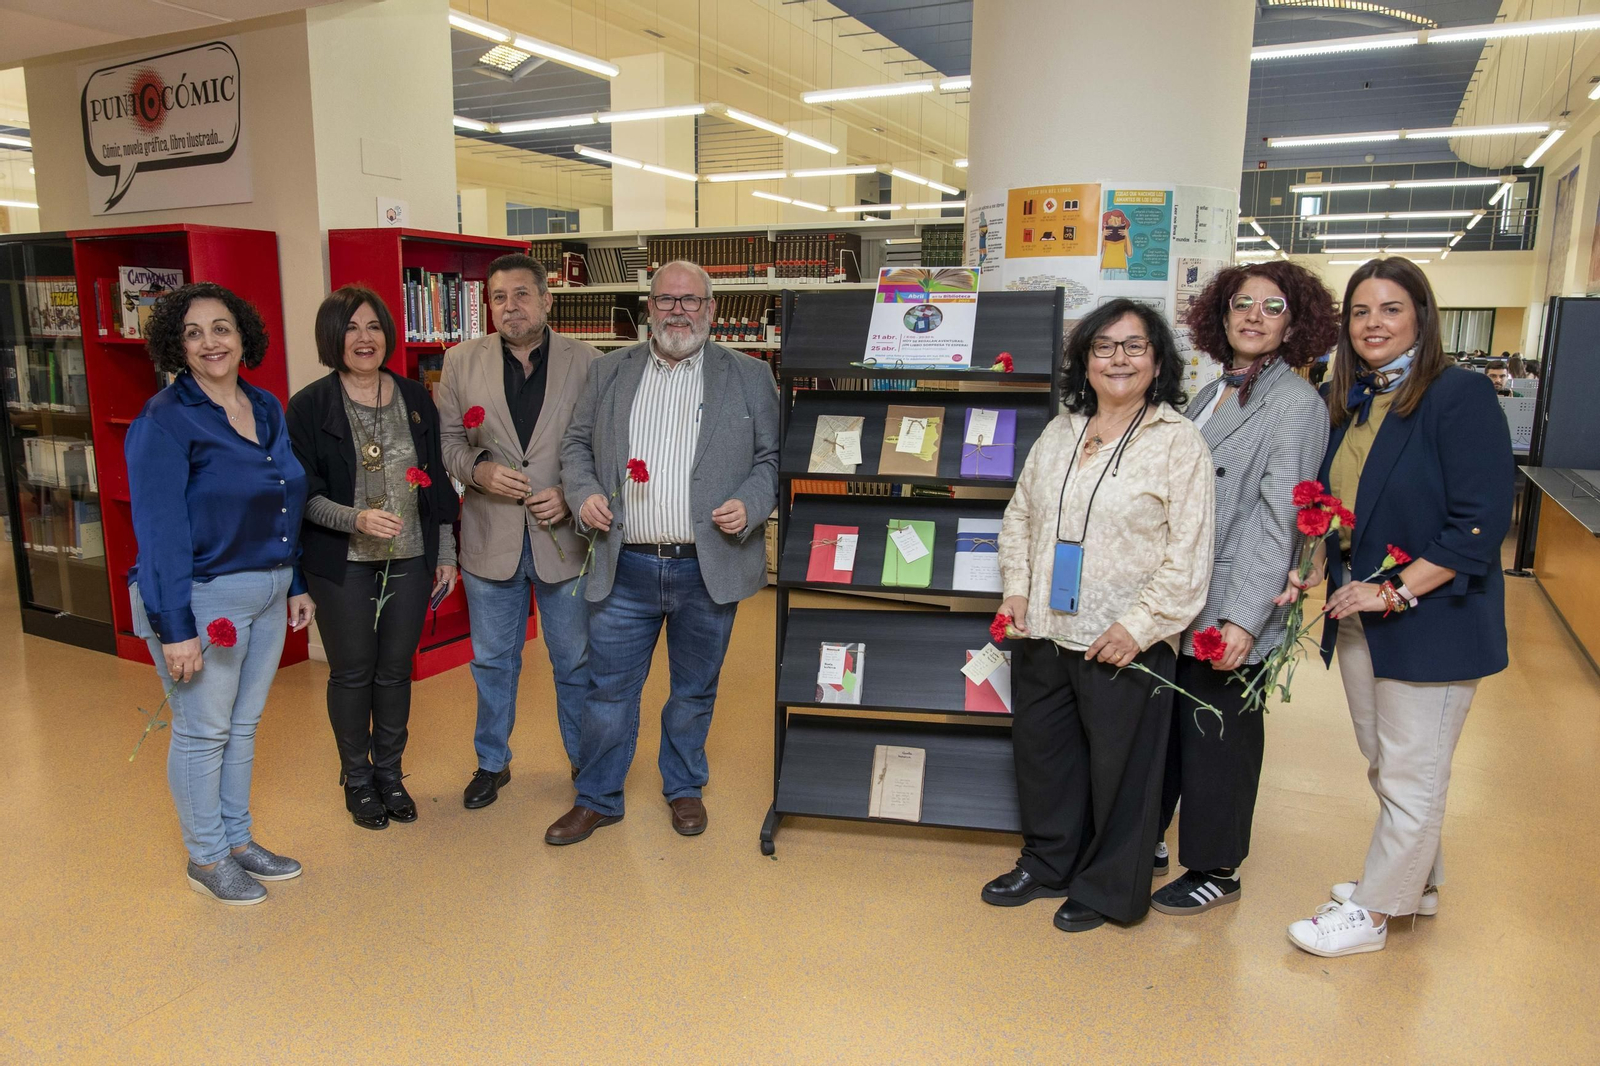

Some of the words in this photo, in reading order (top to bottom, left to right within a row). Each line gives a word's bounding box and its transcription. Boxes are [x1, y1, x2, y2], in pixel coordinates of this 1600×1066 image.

[102, 143, 122, 158] Cómic,
[123, 139, 143, 156] novela
[144, 136, 170, 156] gráfica,
[170, 134, 186, 150] libro
[186, 129, 224, 148] ilustrado...
[128, 269, 178, 285] CATWOMAN
